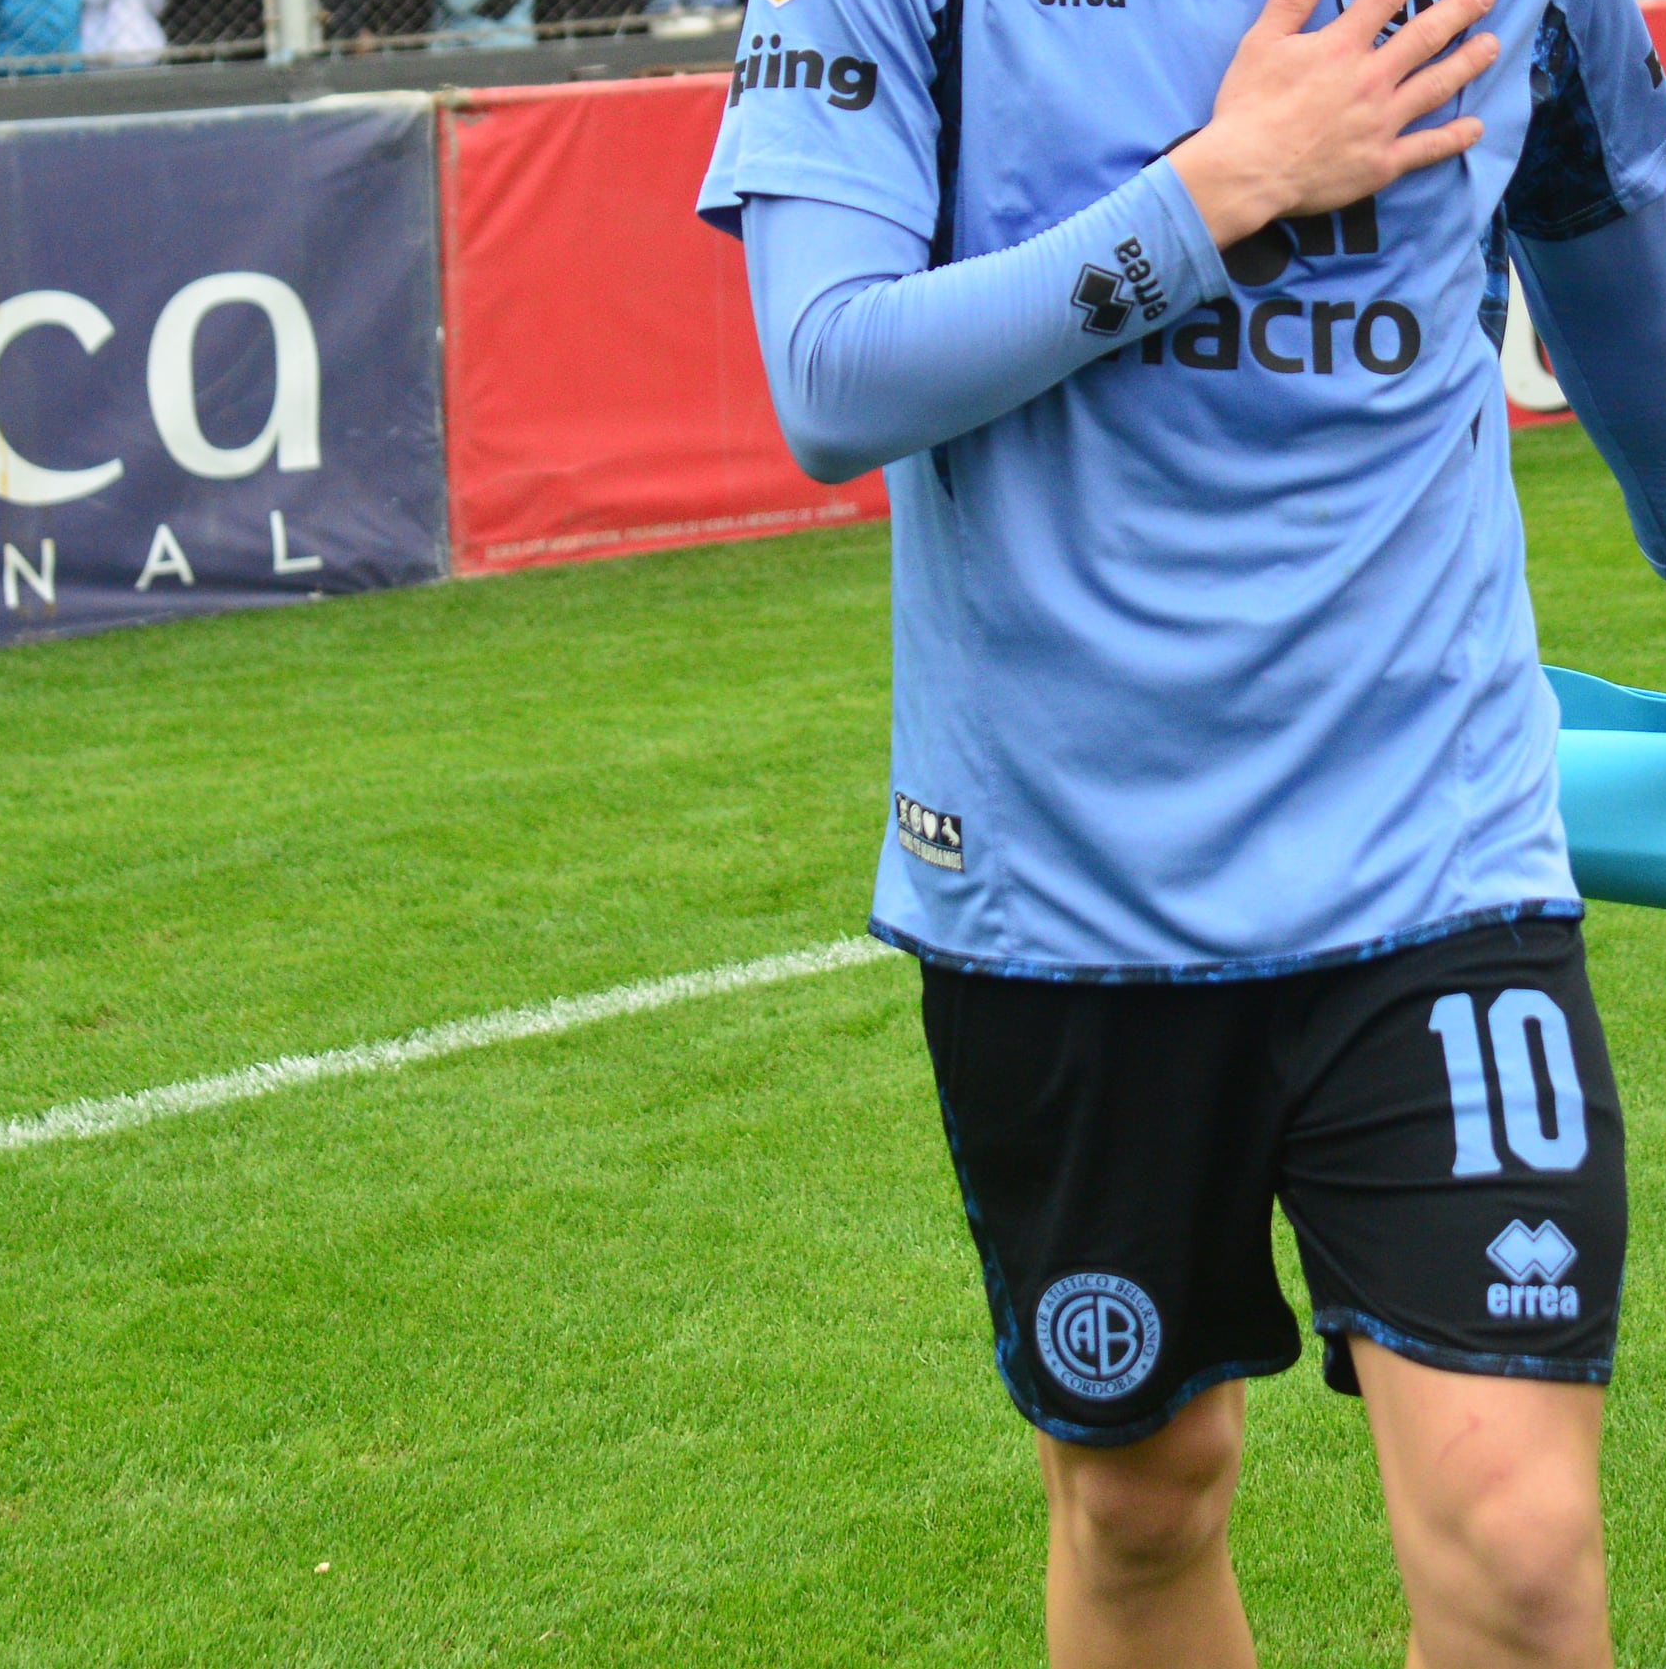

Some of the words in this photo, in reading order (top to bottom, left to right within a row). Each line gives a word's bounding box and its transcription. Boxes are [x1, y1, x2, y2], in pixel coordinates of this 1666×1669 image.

[1114, 235, 1168, 323] errea
[1099, 295, 1421, 375] acro
[1428, 988, 1589, 1178] 10
[1043, 1274, 1109, 1311] ATLETICO
[1115, 1280, 1158, 1357] BELGRANO
[1487, 1282, 1579, 1319] errea
[1039, 1311, 1053, 1354] CLUB
[1061, 1371, 1138, 1395] CORDOBA
